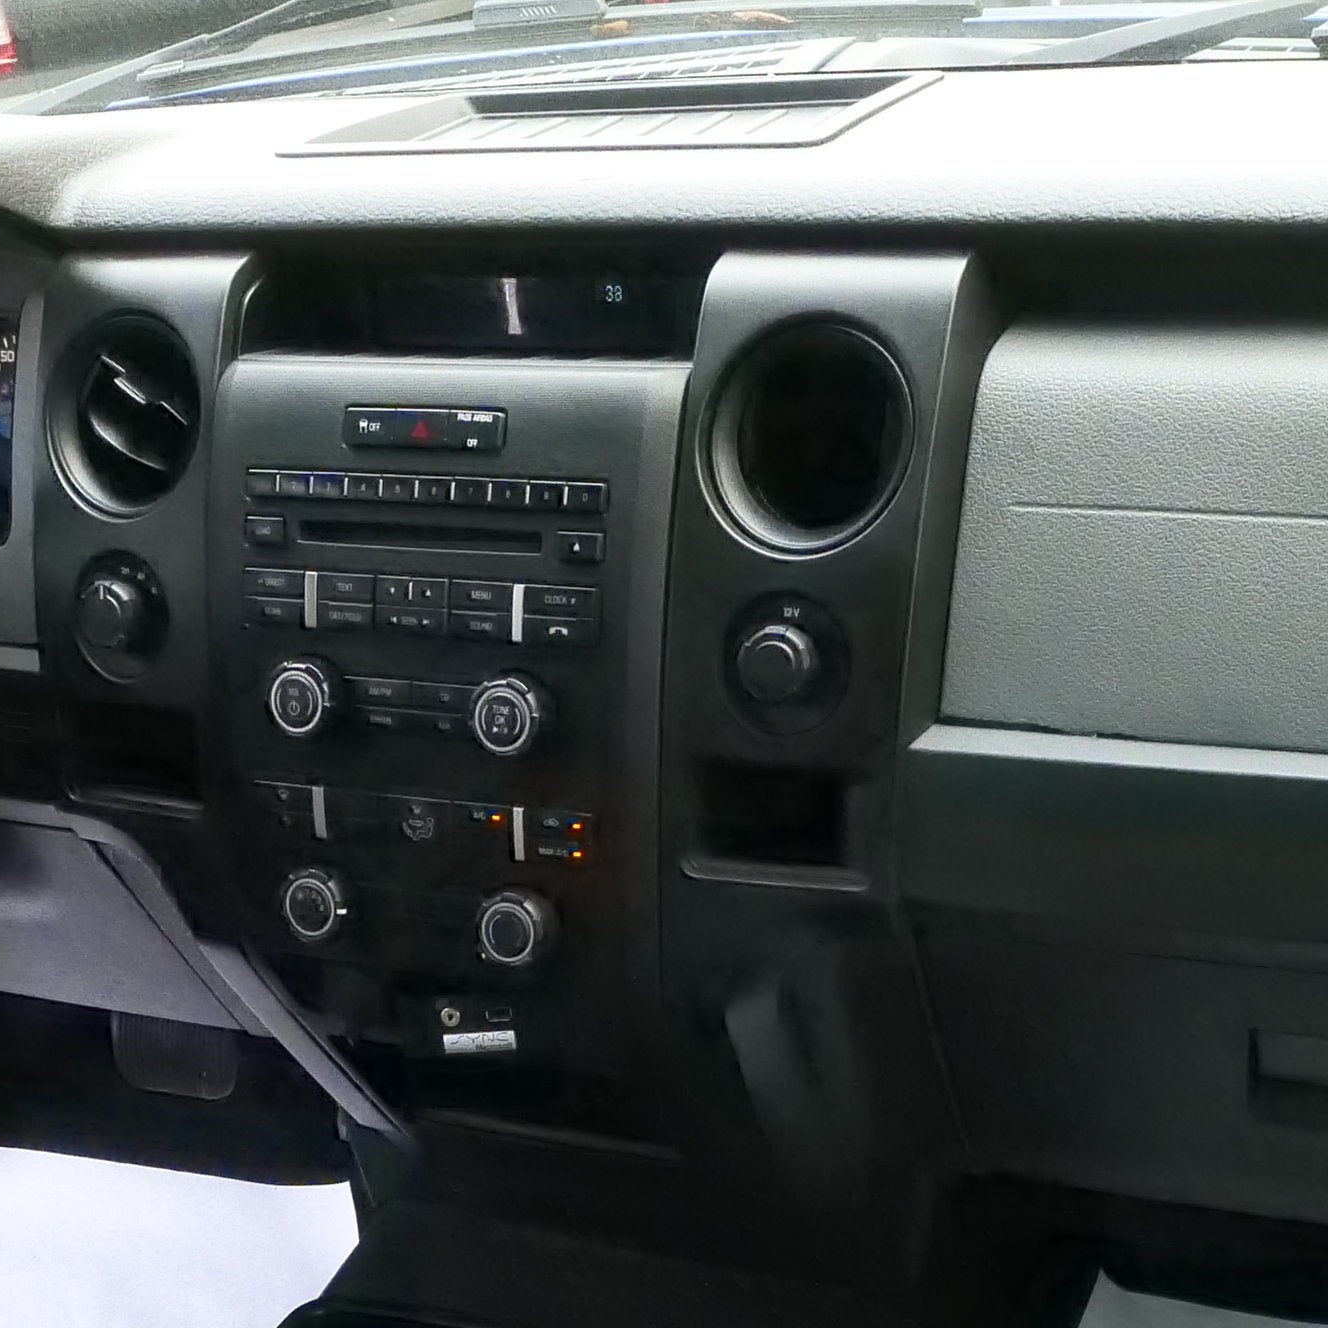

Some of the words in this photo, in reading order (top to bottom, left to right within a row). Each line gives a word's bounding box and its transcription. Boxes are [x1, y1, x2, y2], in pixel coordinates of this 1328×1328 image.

[0, 350, 15, 362] 50
[369, 423, 381, 432] OFF
[466, 439, 478, 448] OFF
[336, 583, 353, 592] TEXT
[471, 590, 492, 600] MENU
[544, 595, 568, 605] CLOCK
[493, 704, 510, 715] TUNE
[494, 715, 506, 725] OK
[450, 1031, 509, 1045] SYNC
